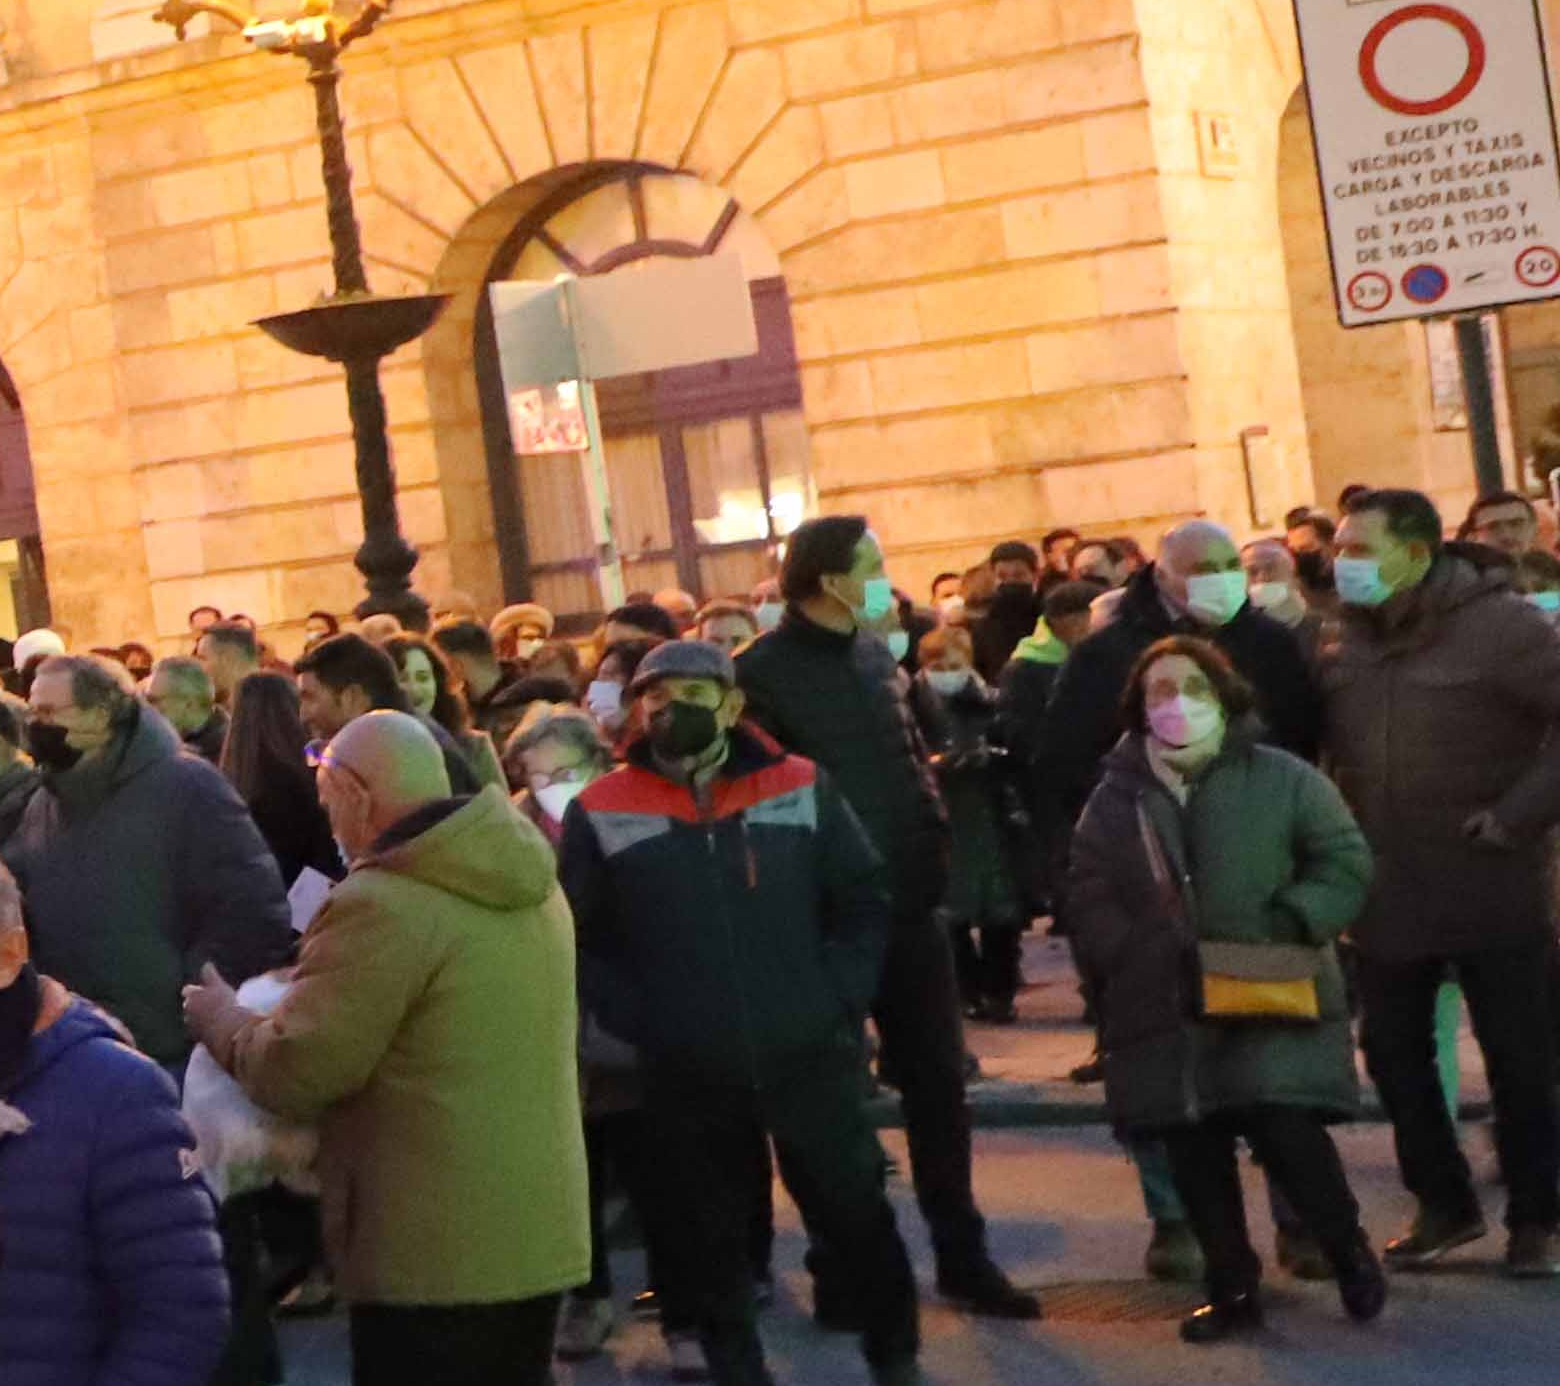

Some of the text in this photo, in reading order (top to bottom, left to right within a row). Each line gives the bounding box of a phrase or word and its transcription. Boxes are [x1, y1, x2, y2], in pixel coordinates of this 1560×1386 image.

[1385, 118, 1478, 146] EXCEPTO
[1348, 133, 1523, 174] VECINOS Y TAXIS
[1334, 153, 1545, 199] CARGA Y DESCARGA
[1374, 181, 1510, 216] LABORABLES
[1356, 225, 1381, 242] DE
[1443, 214, 1455, 228] A
[1518, 202, 1527, 217] Y
[1356, 247, 1382, 264] DE
[1447, 235, 1460, 250] A
